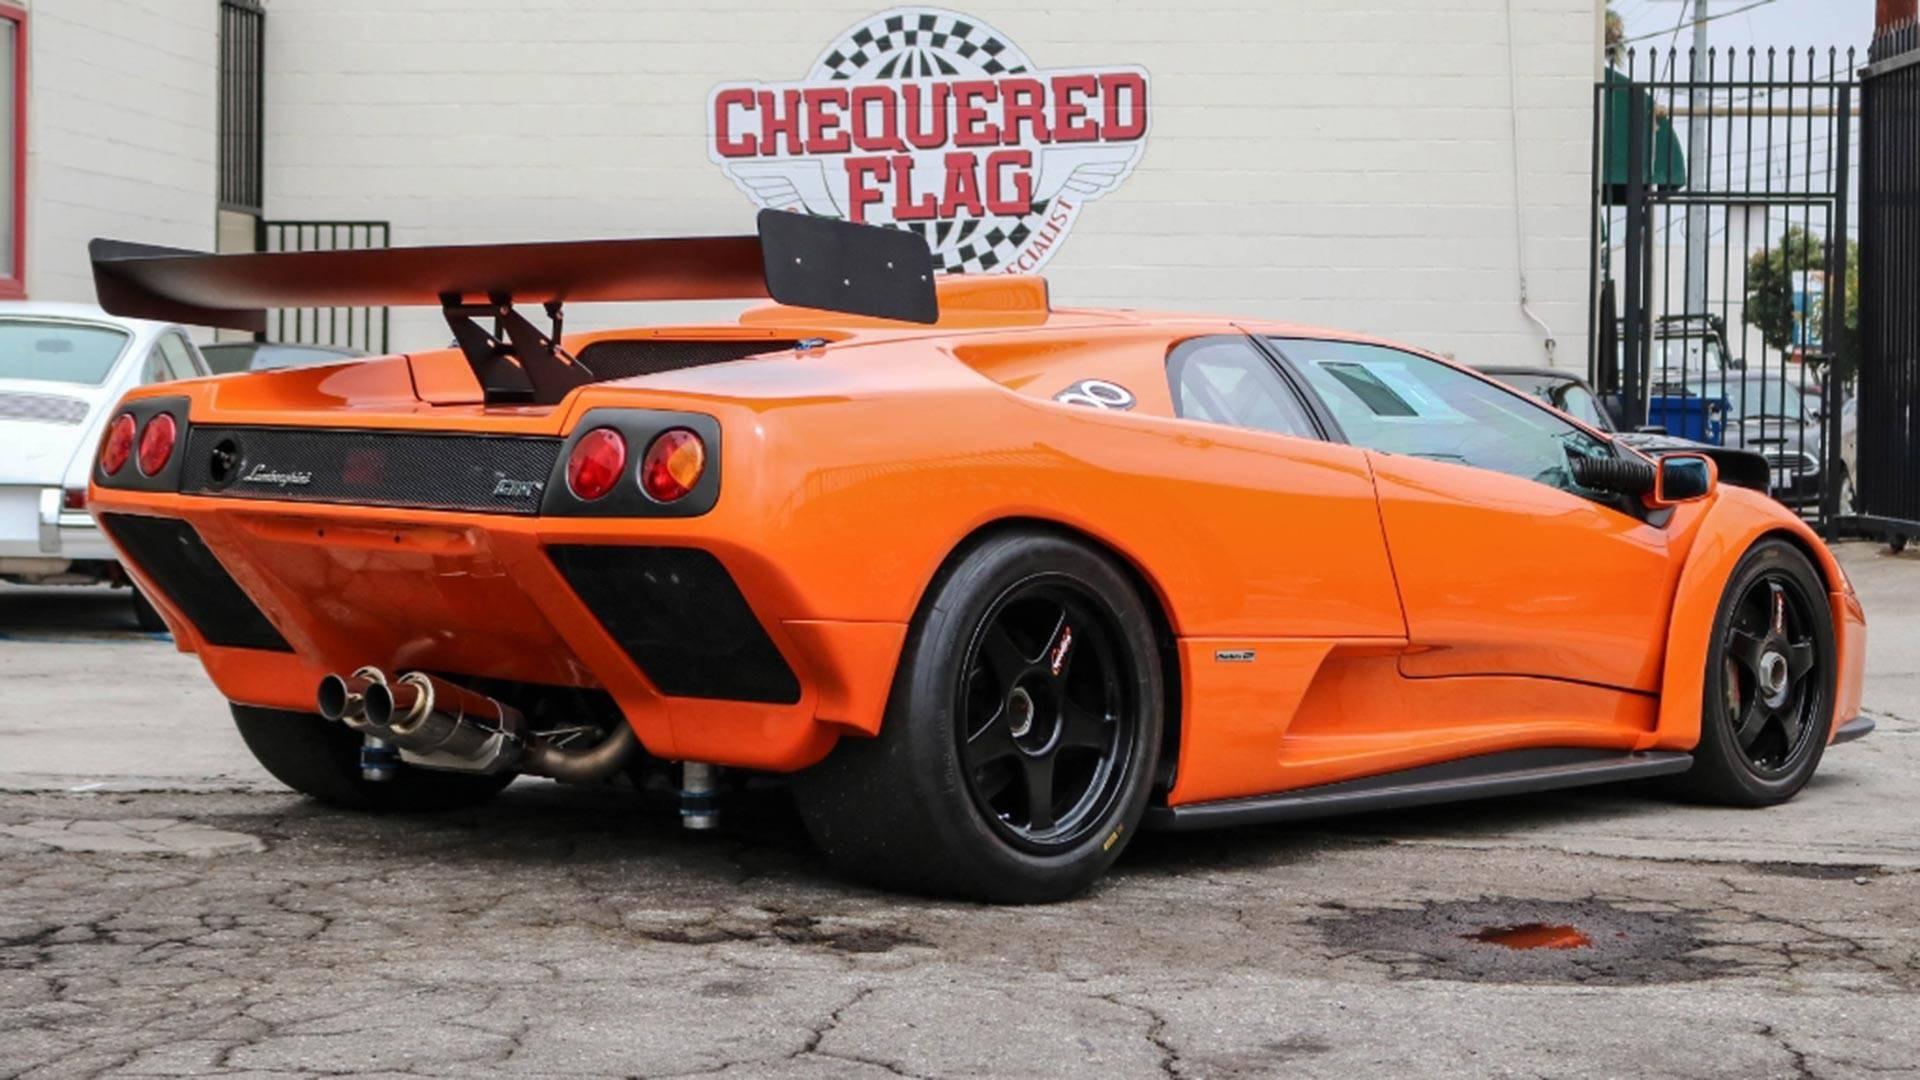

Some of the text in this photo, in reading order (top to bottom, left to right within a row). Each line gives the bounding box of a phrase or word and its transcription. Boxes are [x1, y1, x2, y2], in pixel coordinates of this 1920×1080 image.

[715, 72, 1147, 158] CHEQUERED
[844, 149, 1032, 225] FLAG
[1000, 195, 1073, 274] ECIALIST
